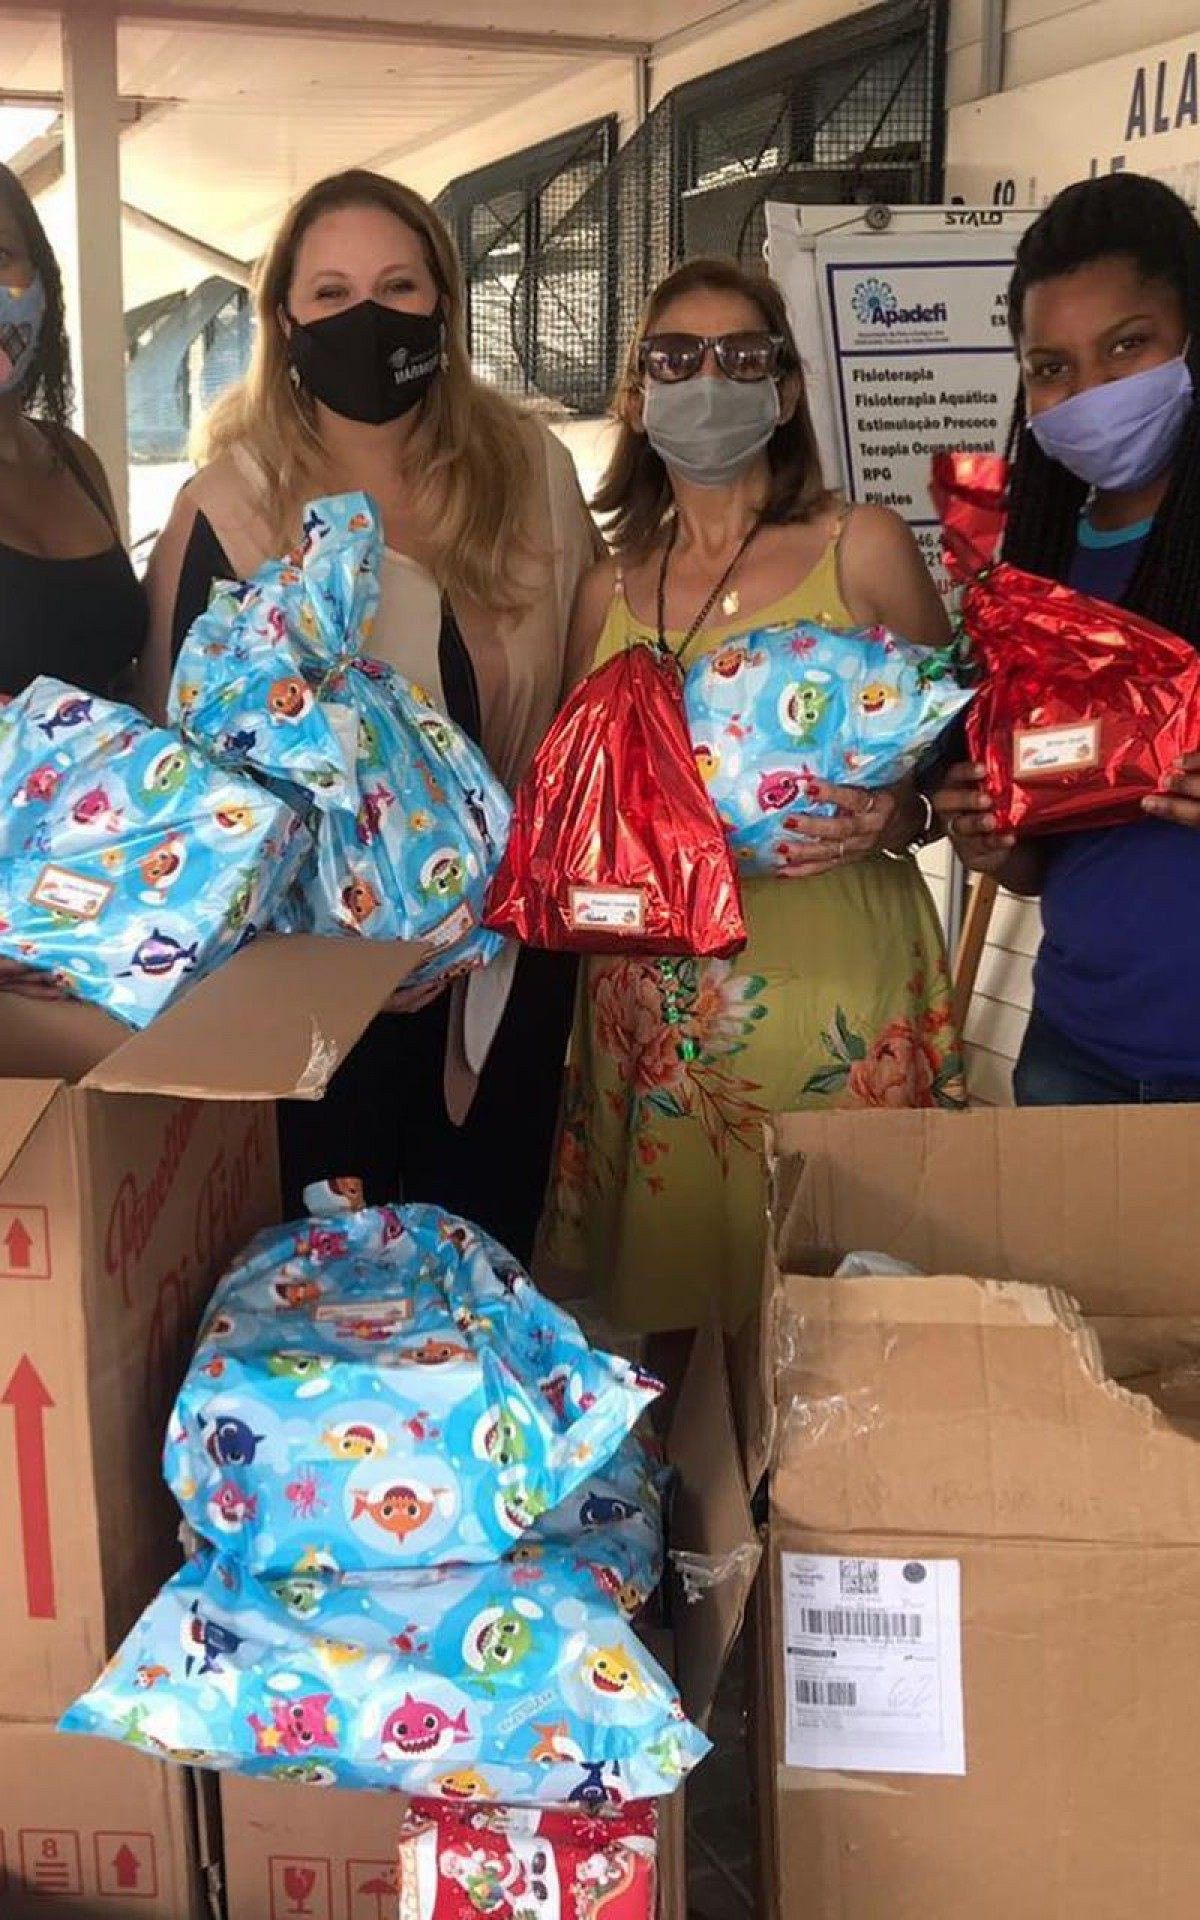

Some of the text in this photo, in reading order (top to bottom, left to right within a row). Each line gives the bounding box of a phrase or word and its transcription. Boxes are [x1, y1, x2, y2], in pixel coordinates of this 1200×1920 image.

[872, 302, 947, 328] Apadefi
[853, 368, 933, 384] Fisioterapia
[855, 391, 997, 408] Fisioterapia Aquática
[857, 417, 941, 432] Estimulação
[859, 442, 910, 458] Terapia
[863, 467, 892, 481] RPG
